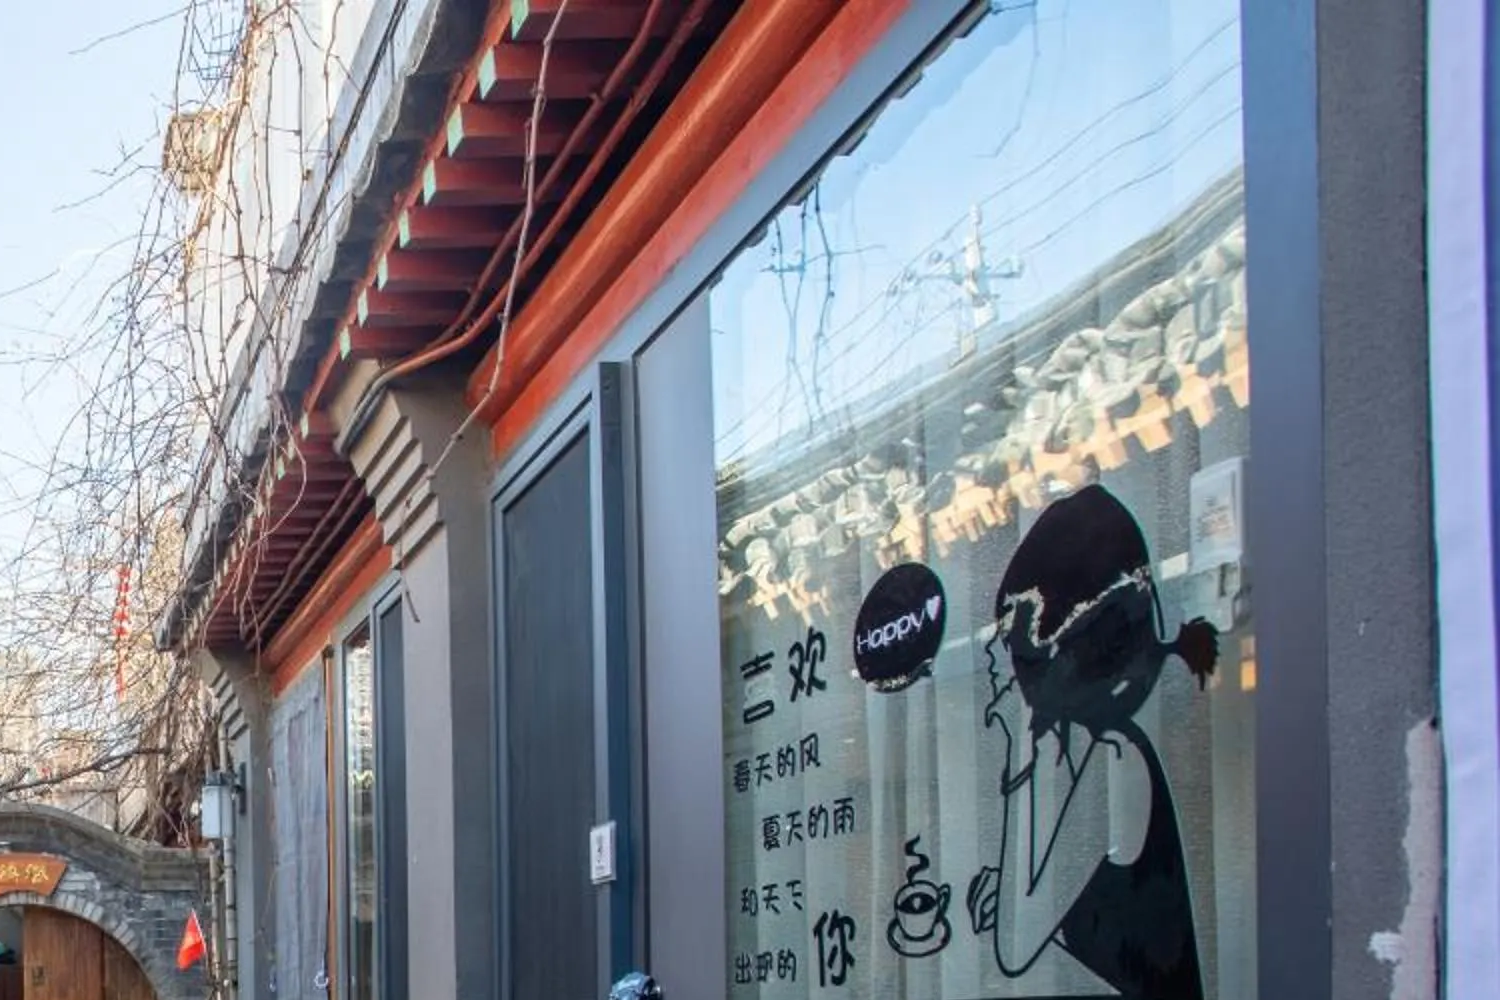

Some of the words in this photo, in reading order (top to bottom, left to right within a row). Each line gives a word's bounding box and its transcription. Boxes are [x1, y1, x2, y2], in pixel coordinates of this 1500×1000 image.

[856, 607, 925, 655] Happy
[733, 732, 821, 793] 春天的风
[762, 797, 855, 851] 夏天的雨
